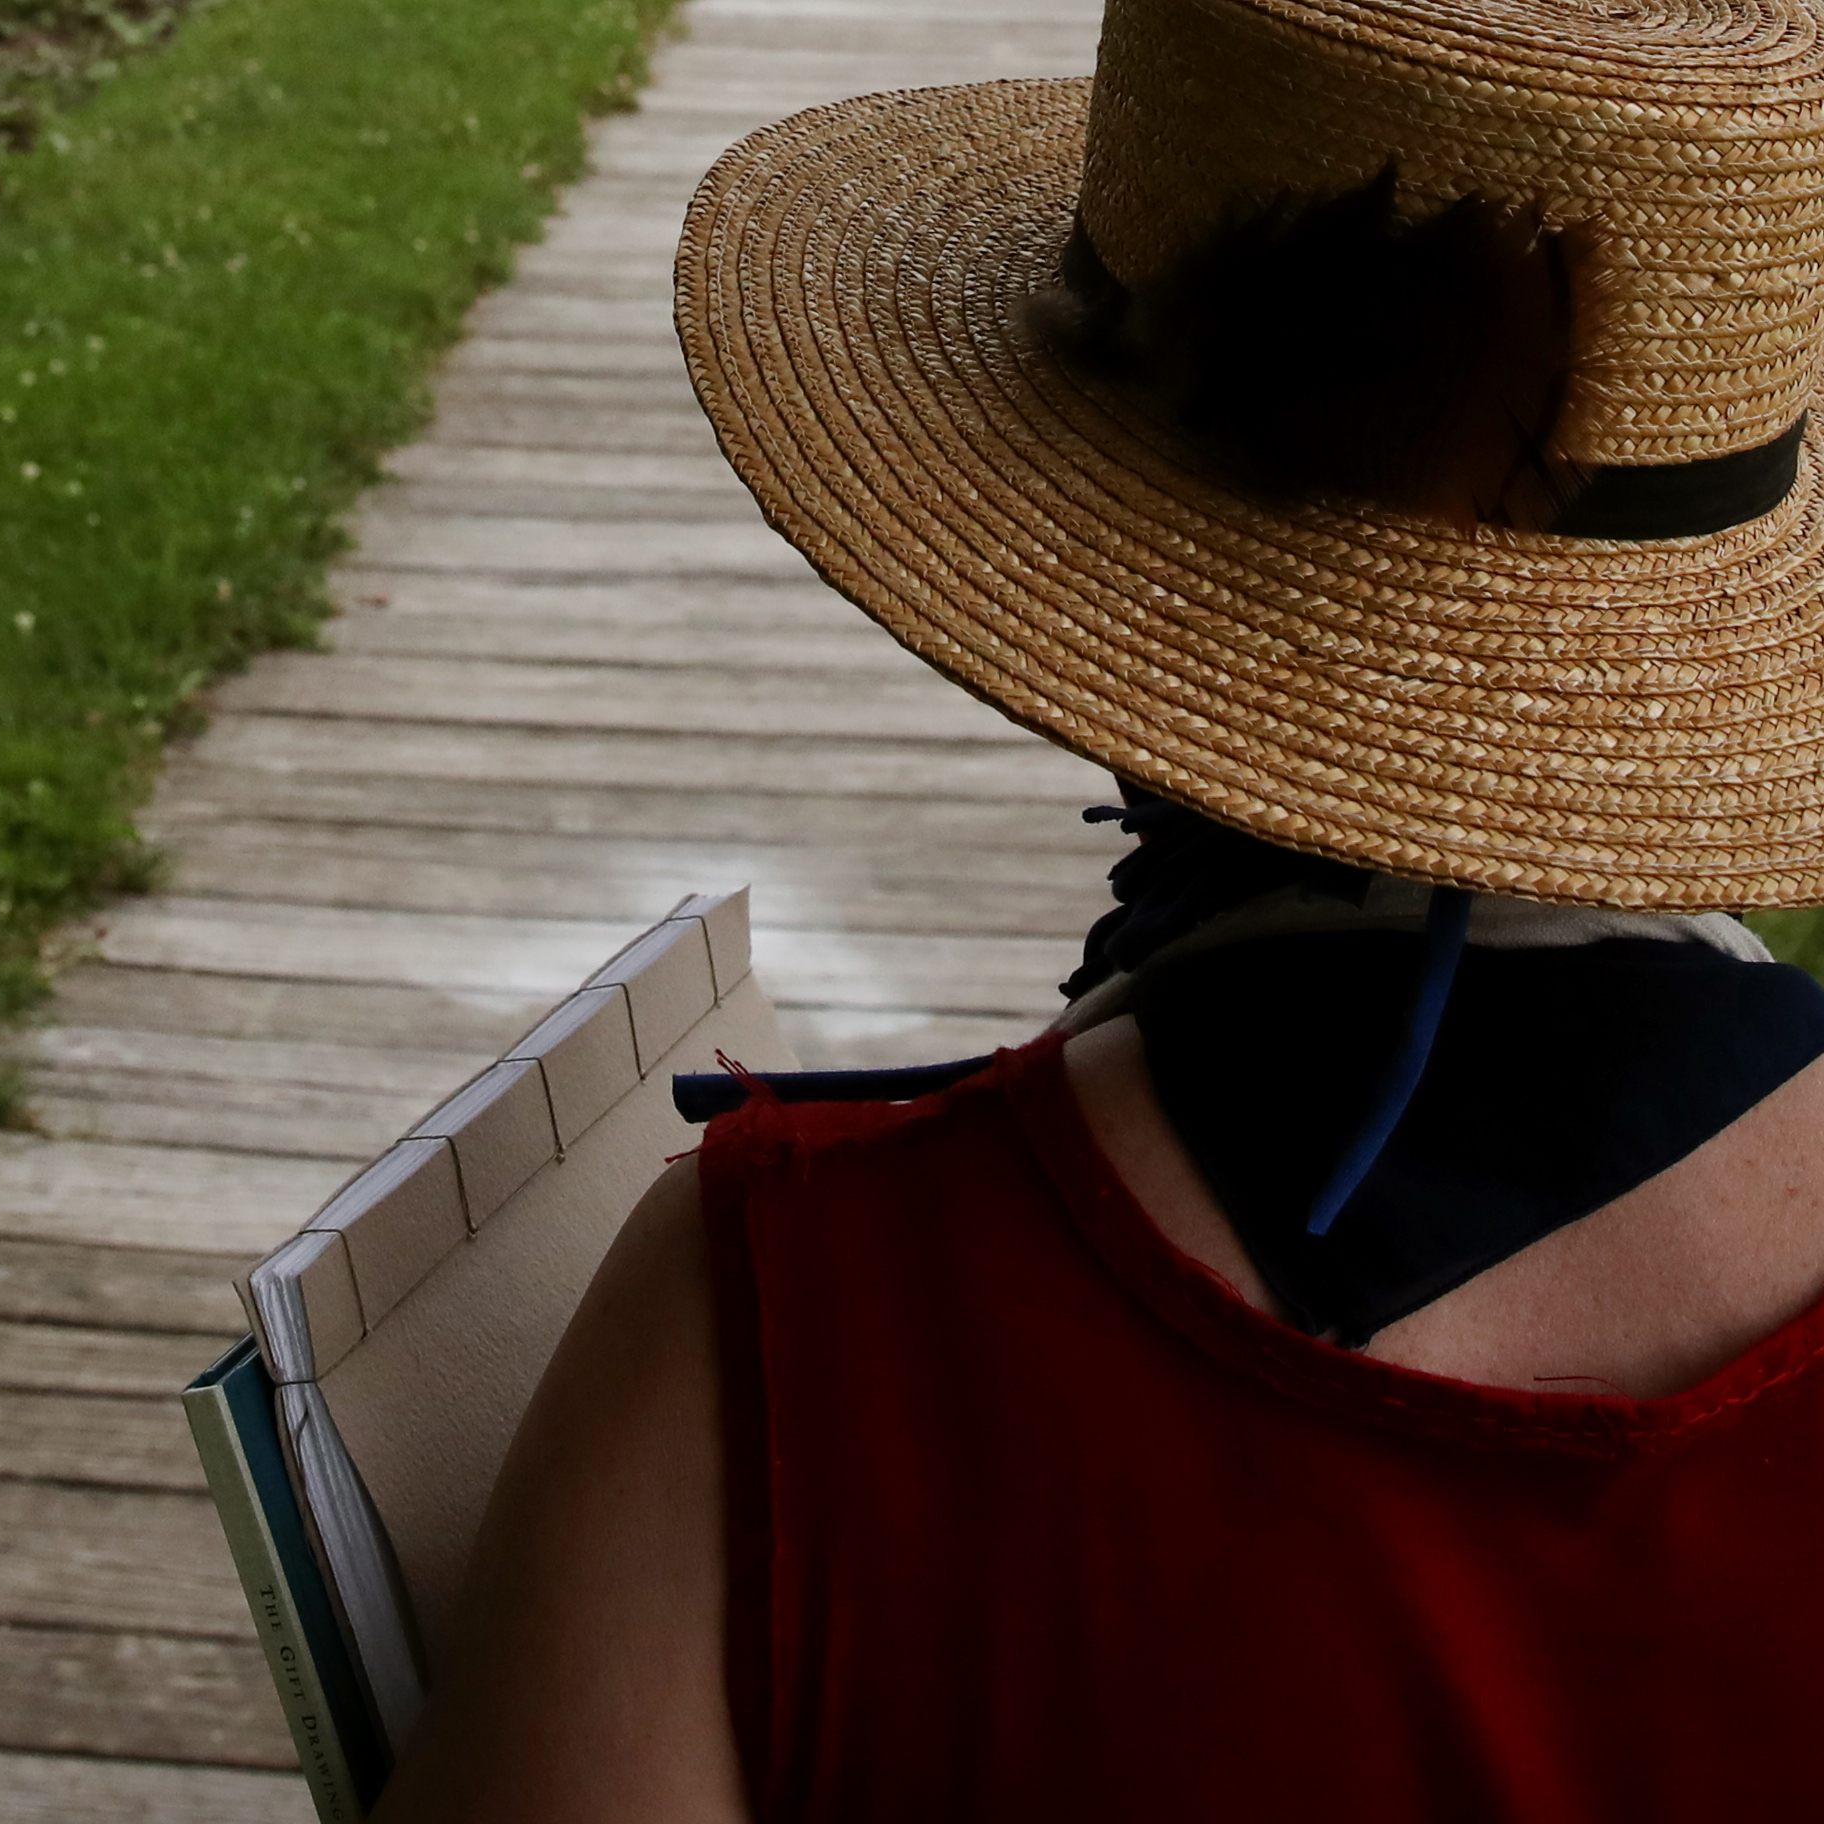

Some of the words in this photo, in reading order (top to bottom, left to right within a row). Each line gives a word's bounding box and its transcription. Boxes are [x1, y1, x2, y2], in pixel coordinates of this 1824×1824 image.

[260, 1585, 283, 1632] THE
[280, 1646, 305, 1700] GIFT
[302, 1714, 344, 1821] DRAWING
